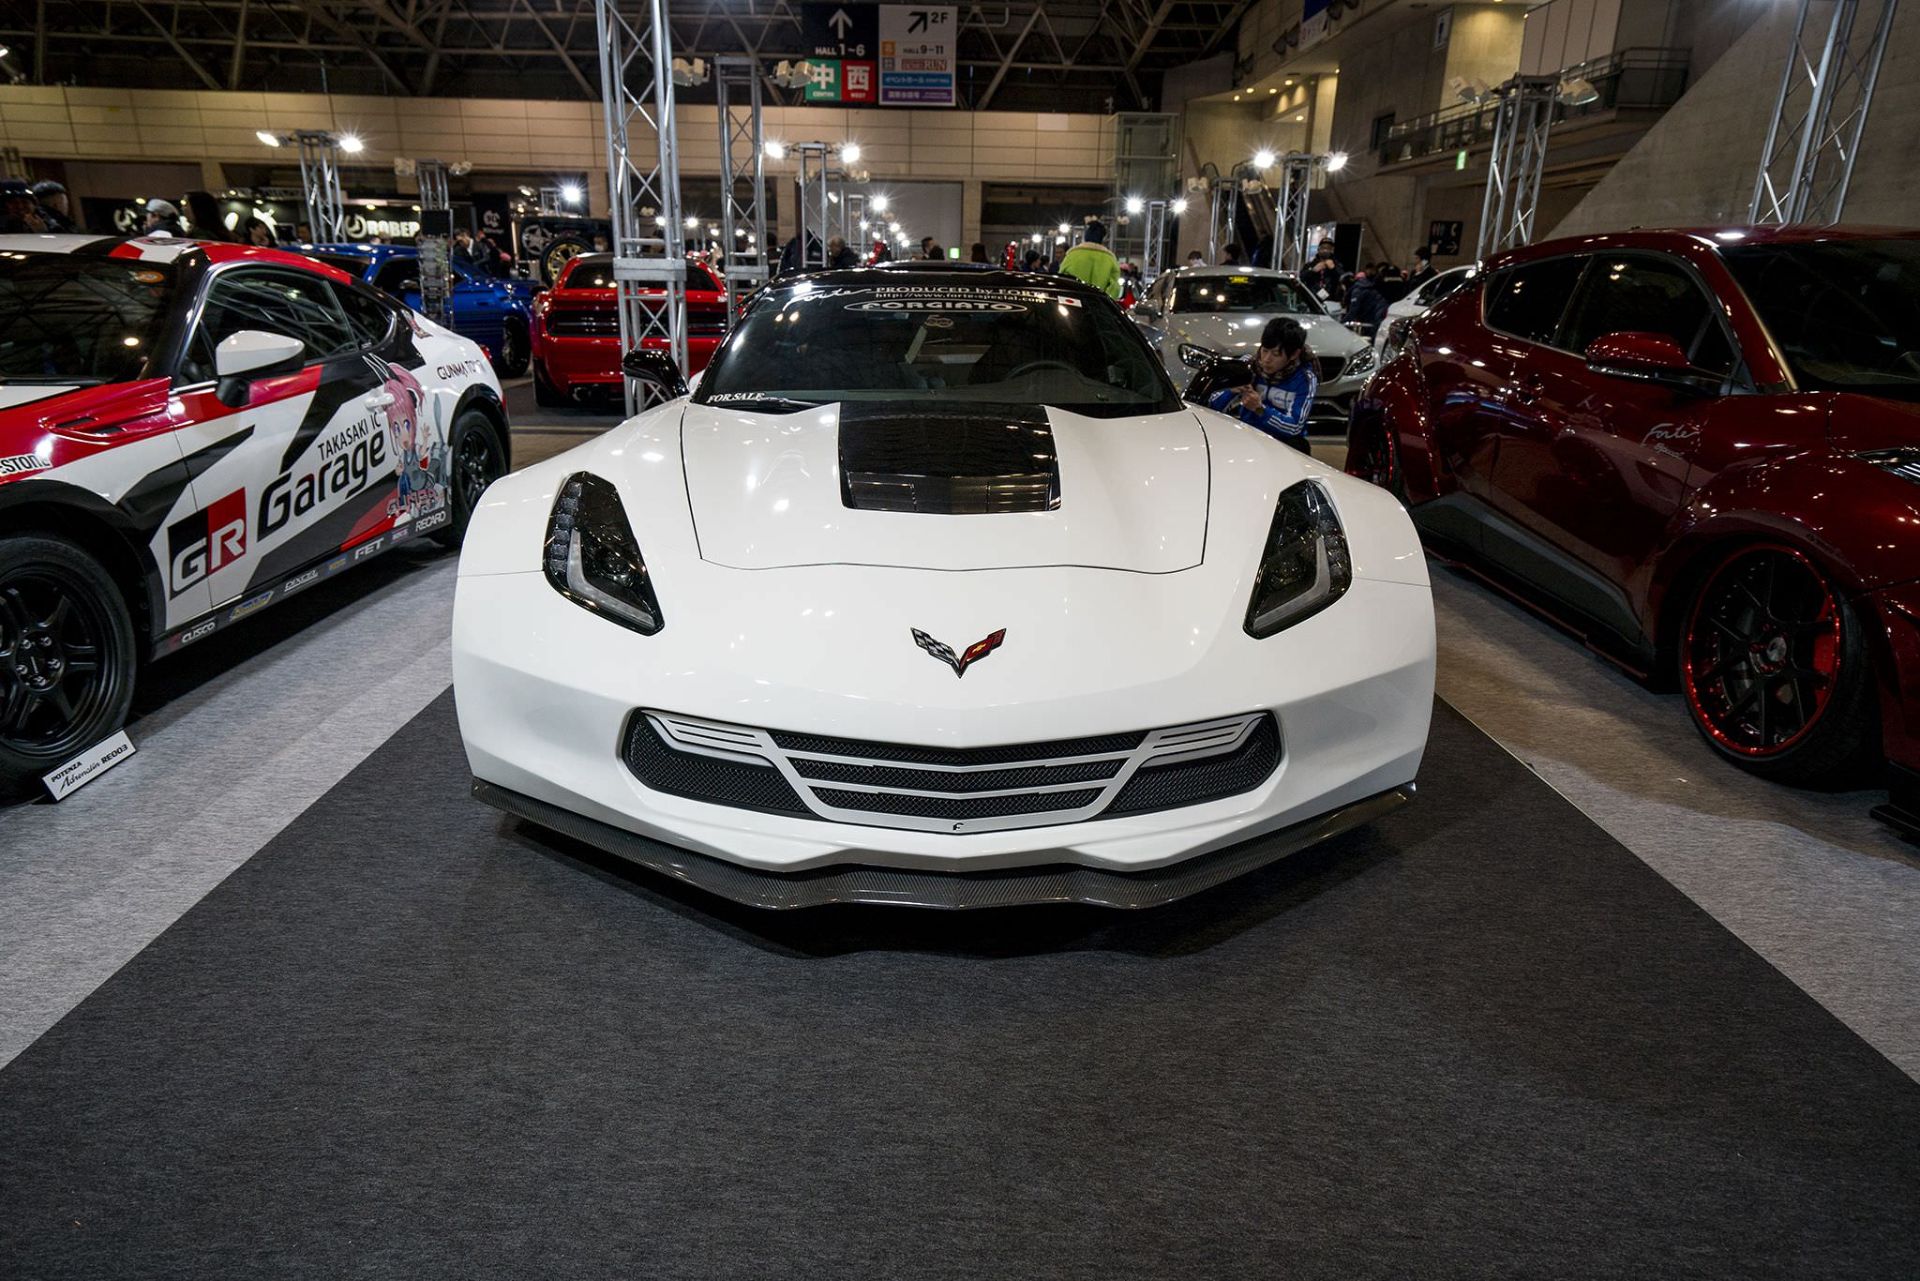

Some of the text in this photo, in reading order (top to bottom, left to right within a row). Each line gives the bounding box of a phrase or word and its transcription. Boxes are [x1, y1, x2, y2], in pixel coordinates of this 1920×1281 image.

[931, 12, 948, 24] 2F
[815, 46, 837, 56] HALL
[812, 63, 835, 90] 中
[846, 65, 871, 91] 西
[876, 286, 1049, 299] PRODUCED by FORTE
[861, 301, 1013, 311] FORGIATO
[706, 391, 765, 404] FOR SALE
[317, 411, 382, 461] TAKASAKI IC
[257, 430, 386, 543] Garage
[415, 510, 446, 532] RECARO
[172, 518, 246, 593] GR
[354, 537, 385, 560] FET
[181, 621, 216, 643] CUSCO
[100, 744, 128, 765] RE003
[51, 761, 82, 783] POTENZA
